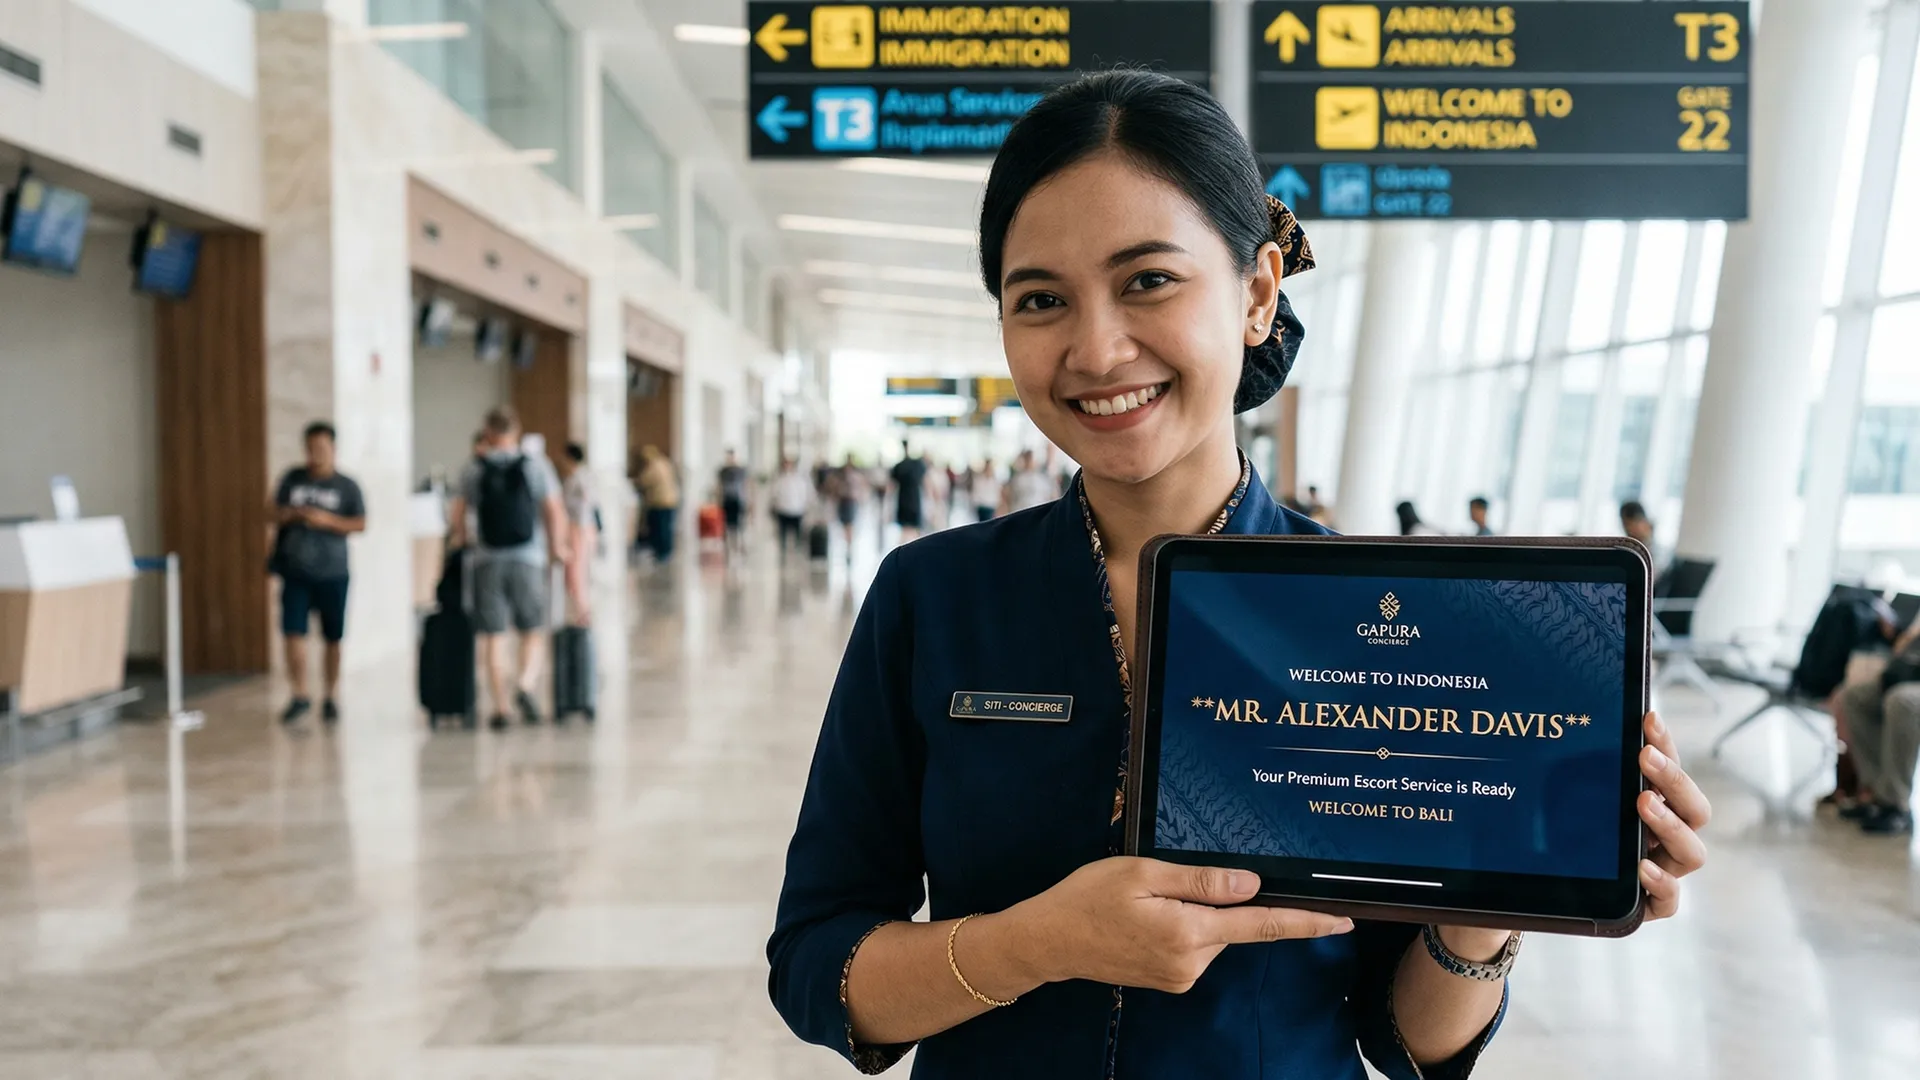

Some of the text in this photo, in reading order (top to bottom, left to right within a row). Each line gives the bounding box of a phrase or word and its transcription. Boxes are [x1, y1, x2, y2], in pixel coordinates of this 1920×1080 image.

[880, 6, 1070, 34] IMMIGRATION
[1384, 6, 1516, 34] ARRIVALS
[1674, 12, 1740, 62] T3
[880, 39, 1070, 67] IMMIGRATION
[1384, 38, 1516, 67] ARRIVALS
[1382, 88, 1573, 118] WELCOME TO
[1677, 86, 1732, 109] GATE
[816, 97, 874, 141] T3
[1677, 109, 1731, 151] 22
[1384, 120, 1537, 149] INDONESIA
[1356, 623, 1421, 639] GAPURA
[1367, 637, 1410, 646] CONCIERGE
[1289, 668, 1489, 690] WELCOME TO INDONESIA
[984, 700, 1002, 710] SITI
[1009, 702, 1063, 712] CONCIERGE
[1275, 700, 1463, 734] ALEXANDER
[1252, 768, 1516, 801] Your Premium Escort Service is Ready
[1308, 800, 1454, 822] WELCOME TO BALI
